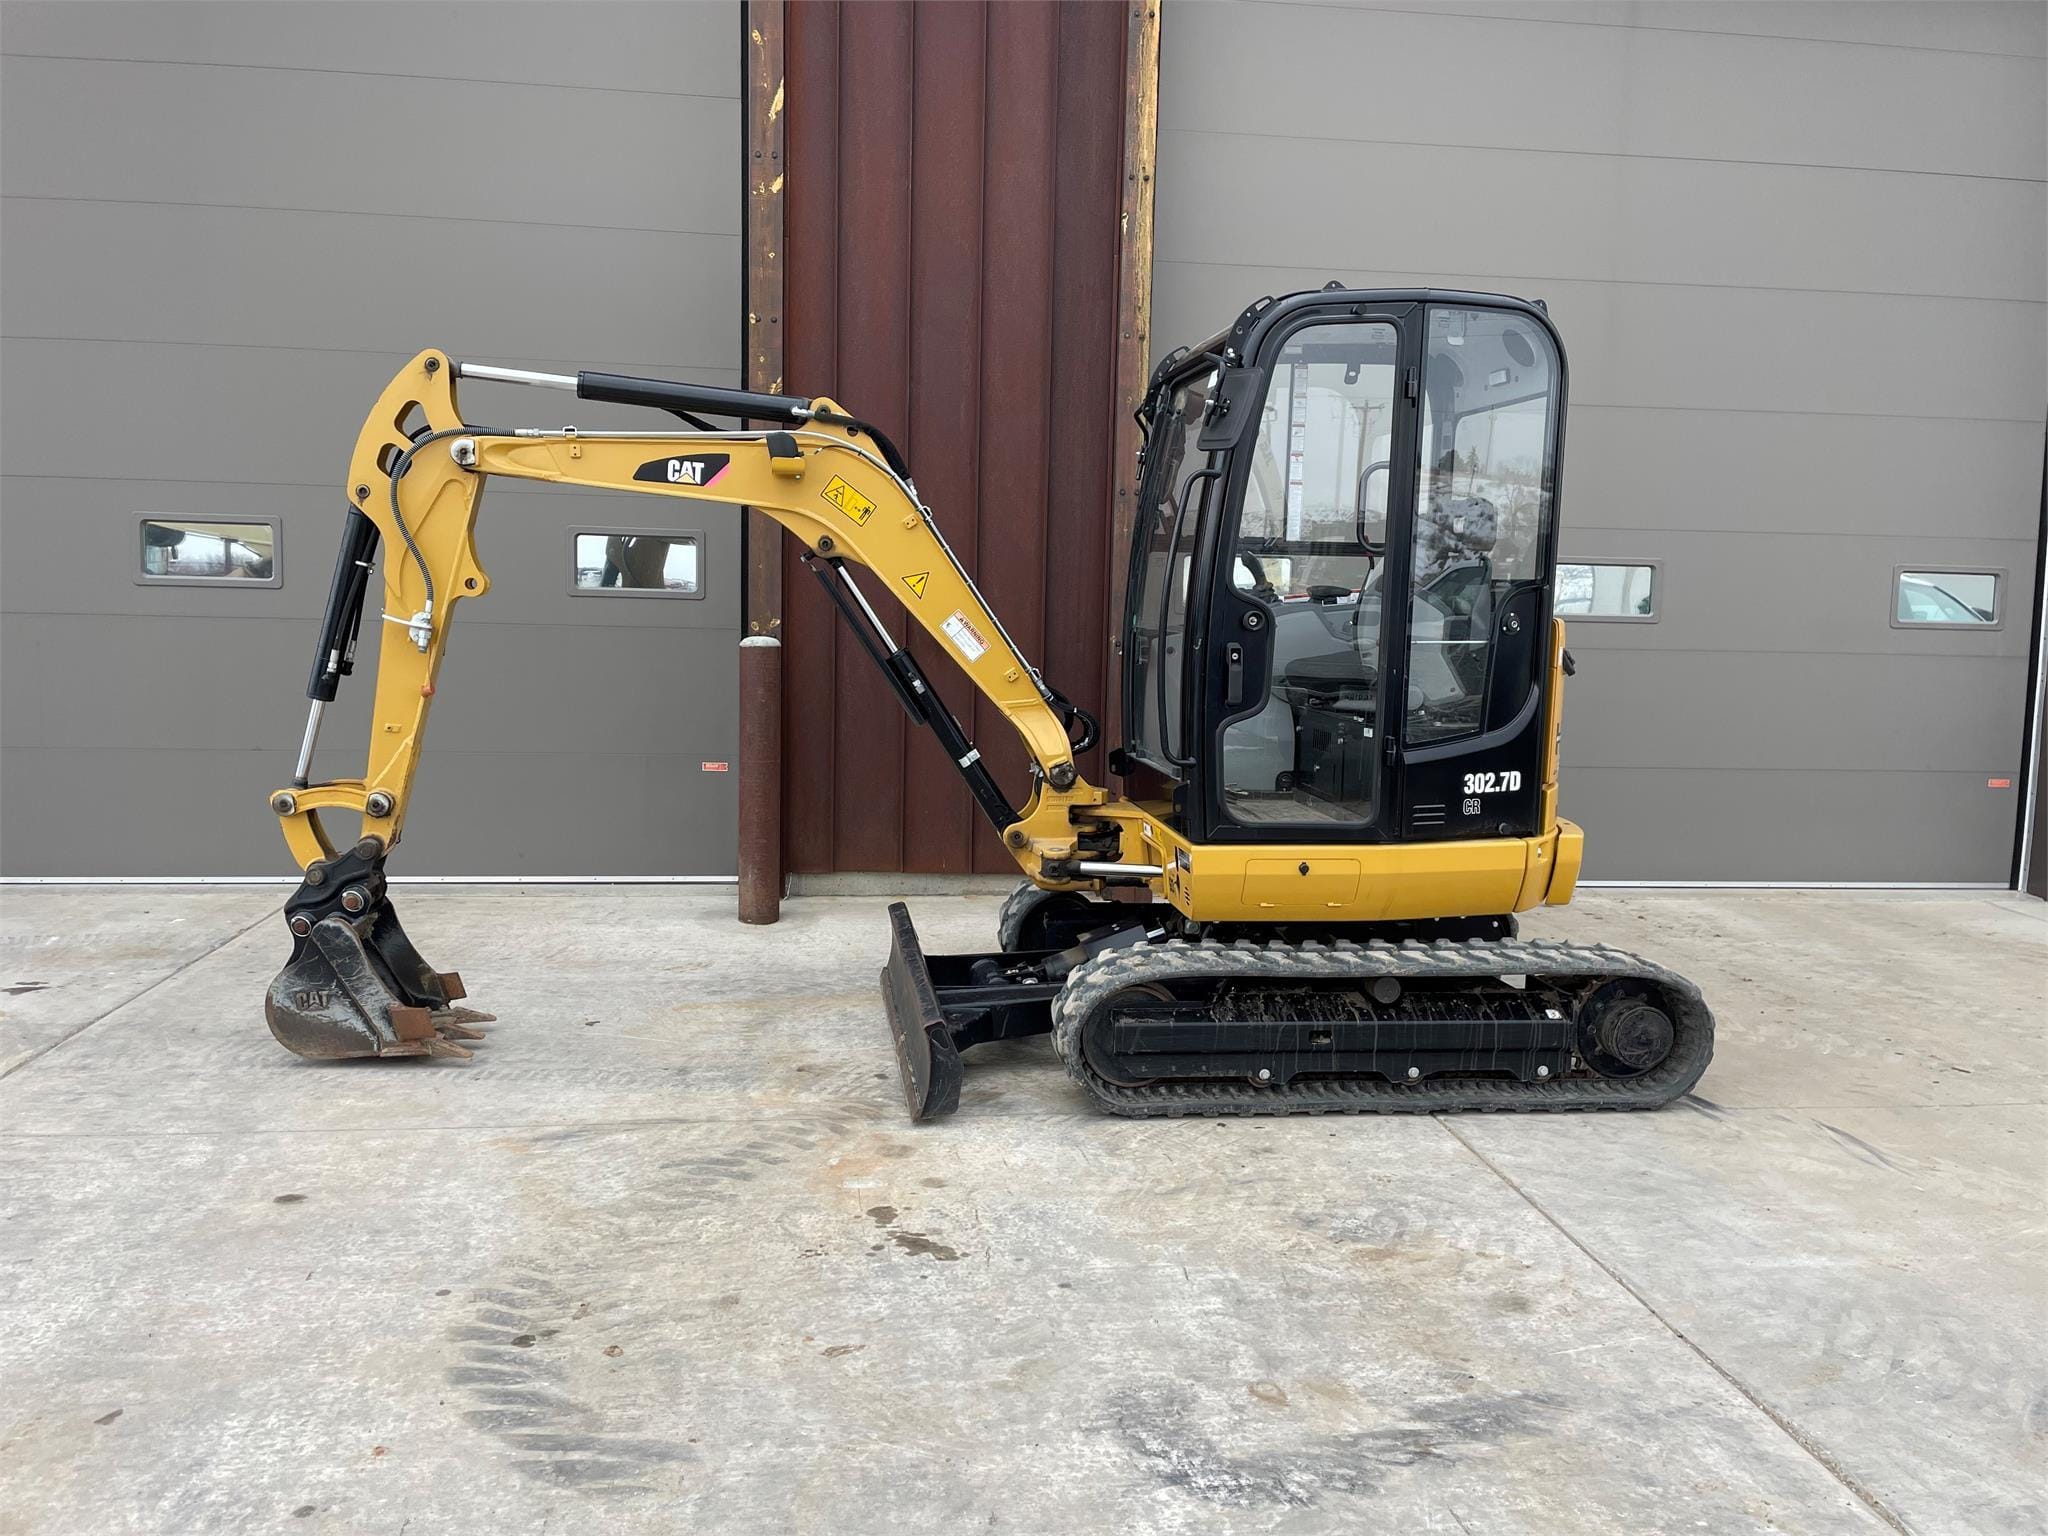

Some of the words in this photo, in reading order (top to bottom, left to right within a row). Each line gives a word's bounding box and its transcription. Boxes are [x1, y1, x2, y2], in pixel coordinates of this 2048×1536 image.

[667, 459, 704, 484] CAT
[963, 621, 984, 645] WARNING
[1463, 770, 1521, 794] 302.7D
[1463, 798, 1481, 815] CR
[296, 991, 330, 1011] CAT
